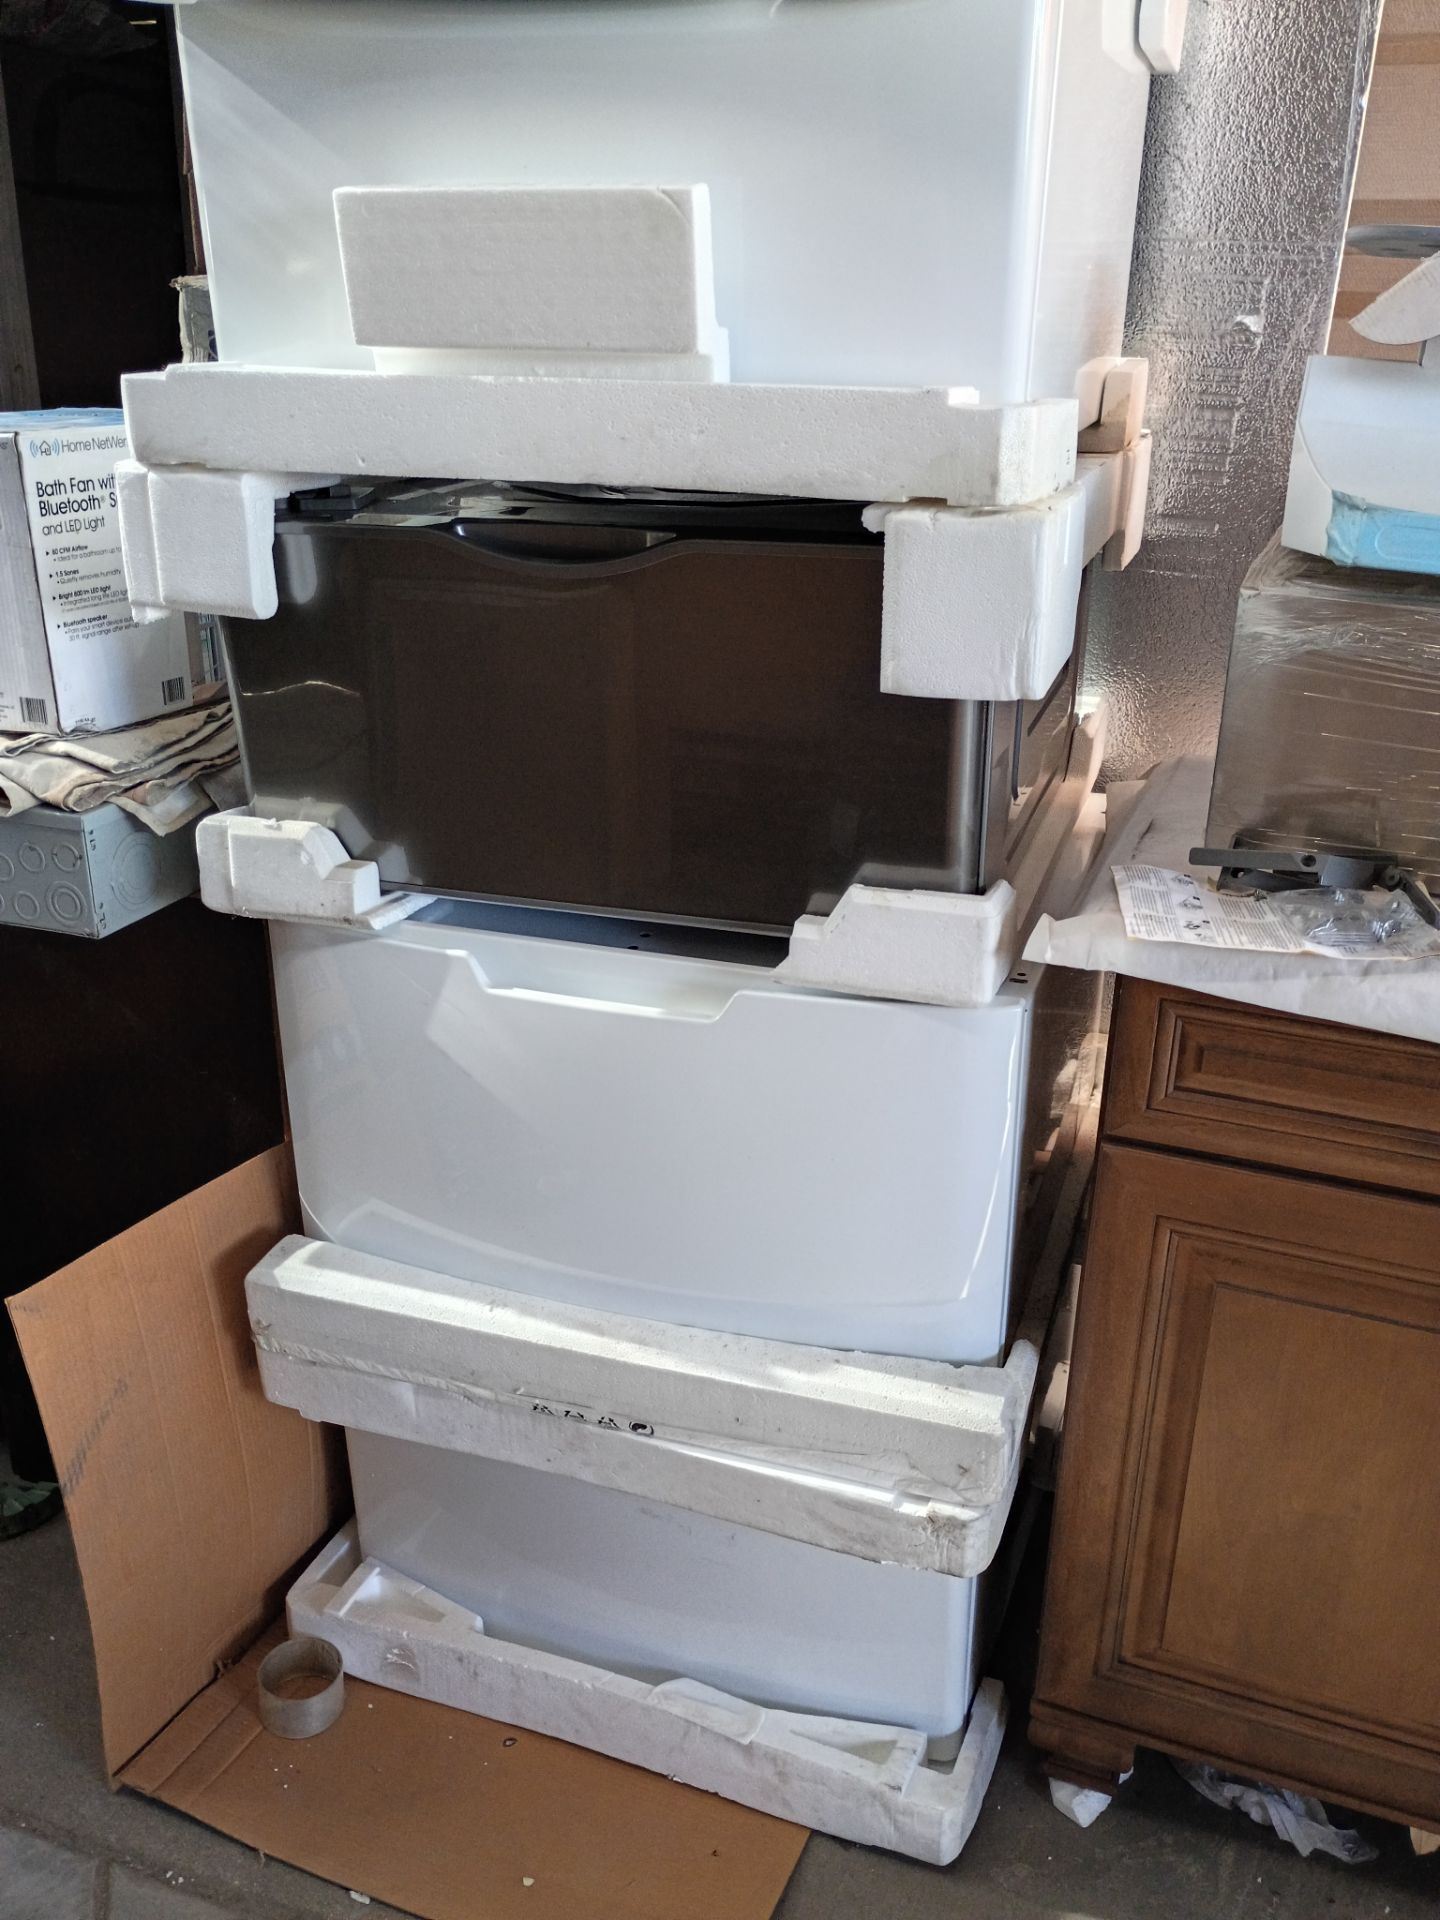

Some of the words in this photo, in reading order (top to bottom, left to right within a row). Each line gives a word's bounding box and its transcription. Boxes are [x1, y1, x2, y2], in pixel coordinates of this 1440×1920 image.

[92, 436, 128, 451] NetWer
[36, 480, 67, 498] Bath
[69, 477, 95, 493] Fan
[98, 473, 115, 490] wit
[109, 491, 117, 508] S
[42, 521, 62, 536] and
[64, 518, 82, 533] LED
[83, 515, 105, 532] Light
[63, 618, 86, 628] Bluetooth
